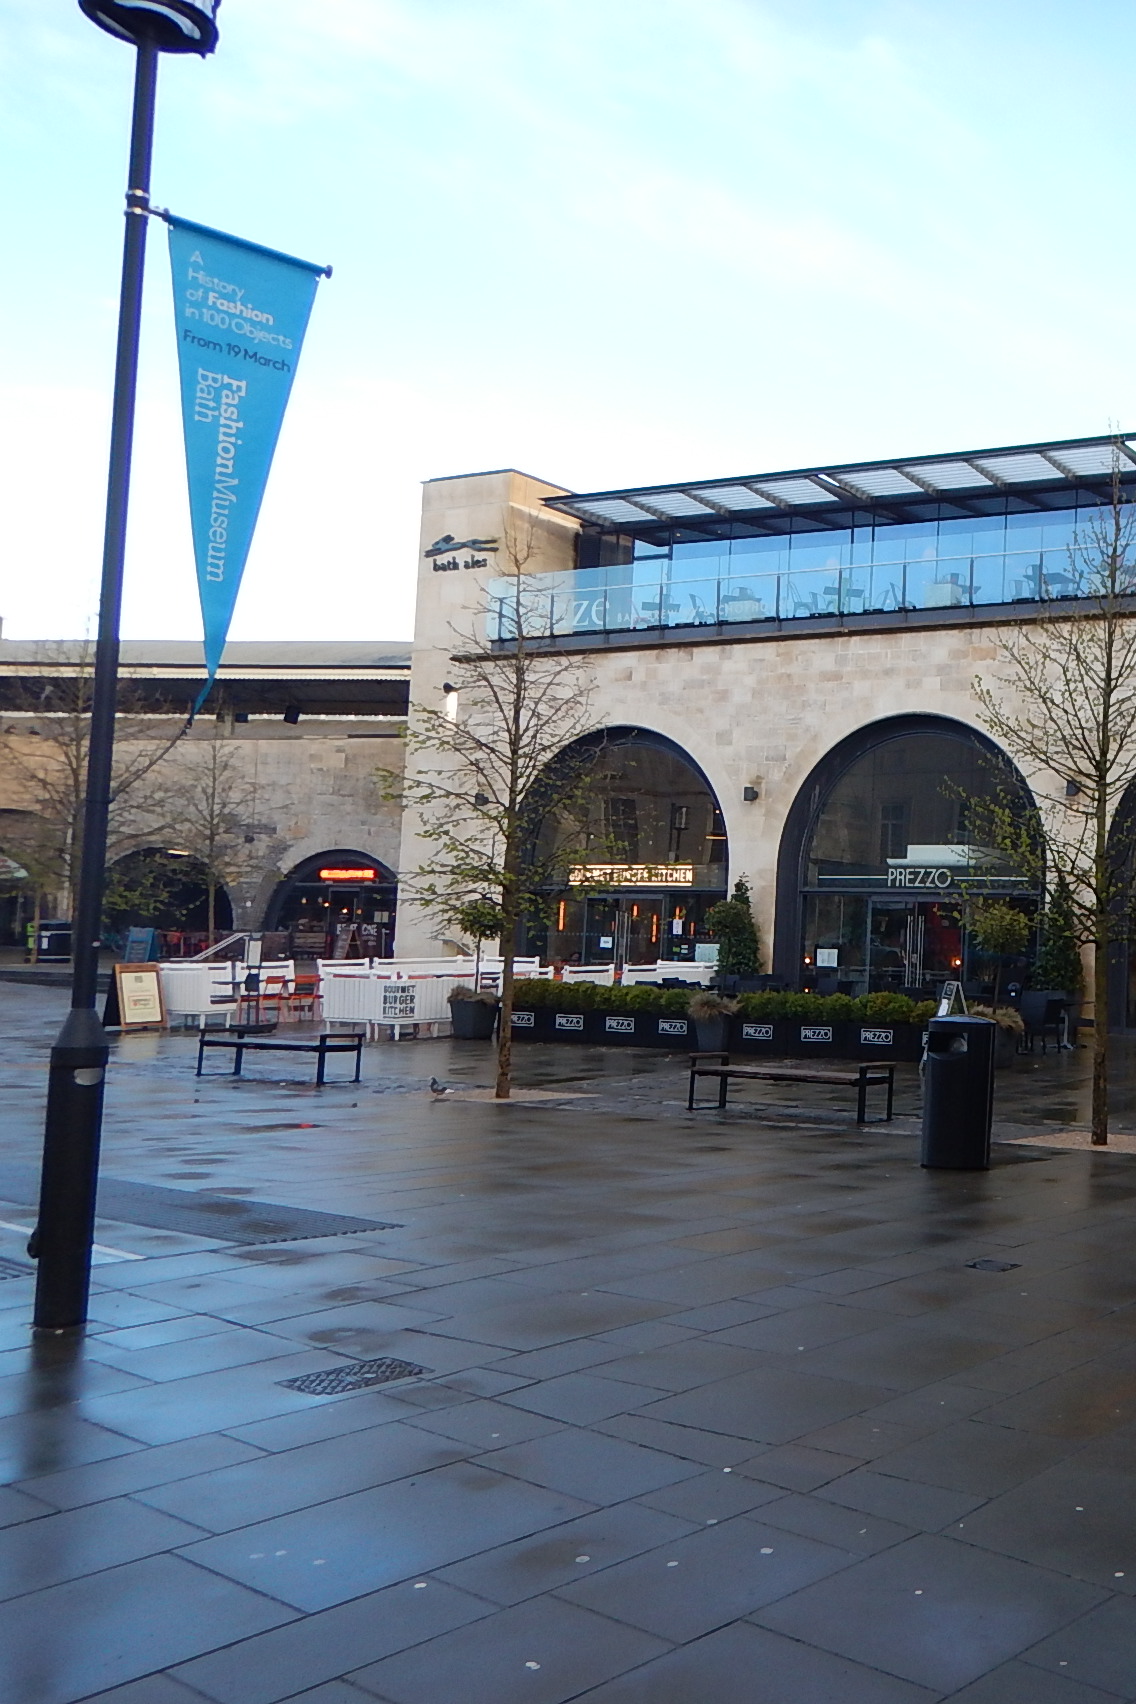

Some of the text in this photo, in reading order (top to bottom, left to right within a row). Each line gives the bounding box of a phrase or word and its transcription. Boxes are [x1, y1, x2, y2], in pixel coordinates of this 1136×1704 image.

[190, 250, 204, 266] A
[187, 267, 245, 300] History
[186, 288, 275, 326] of Fashion
[185, 303, 293, 350] in 100 Objects
[183, 328, 292, 373] From 19 March
[194, 367, 222, 423] Bath
[432, 554, 488, 572] bath ales
[887, 868, 952, 888] PREZZO
[383, 994, 416, 1006] BURGER
[382, 1005, 416, 1016] KITCHEN
[511, 1014, 532, 1024] REZZO
[557, 1017, 581, 1027] PREZZO
[607, 1020, 632, 1030] PREZZO
[660, 1022, 685, 1032] PREZZO
[744, 1026, 771, 1037] PREZZO
[802, 1029, 830, 1039] PREZZO
[862, 1031, 892, 1042] PREZZO
